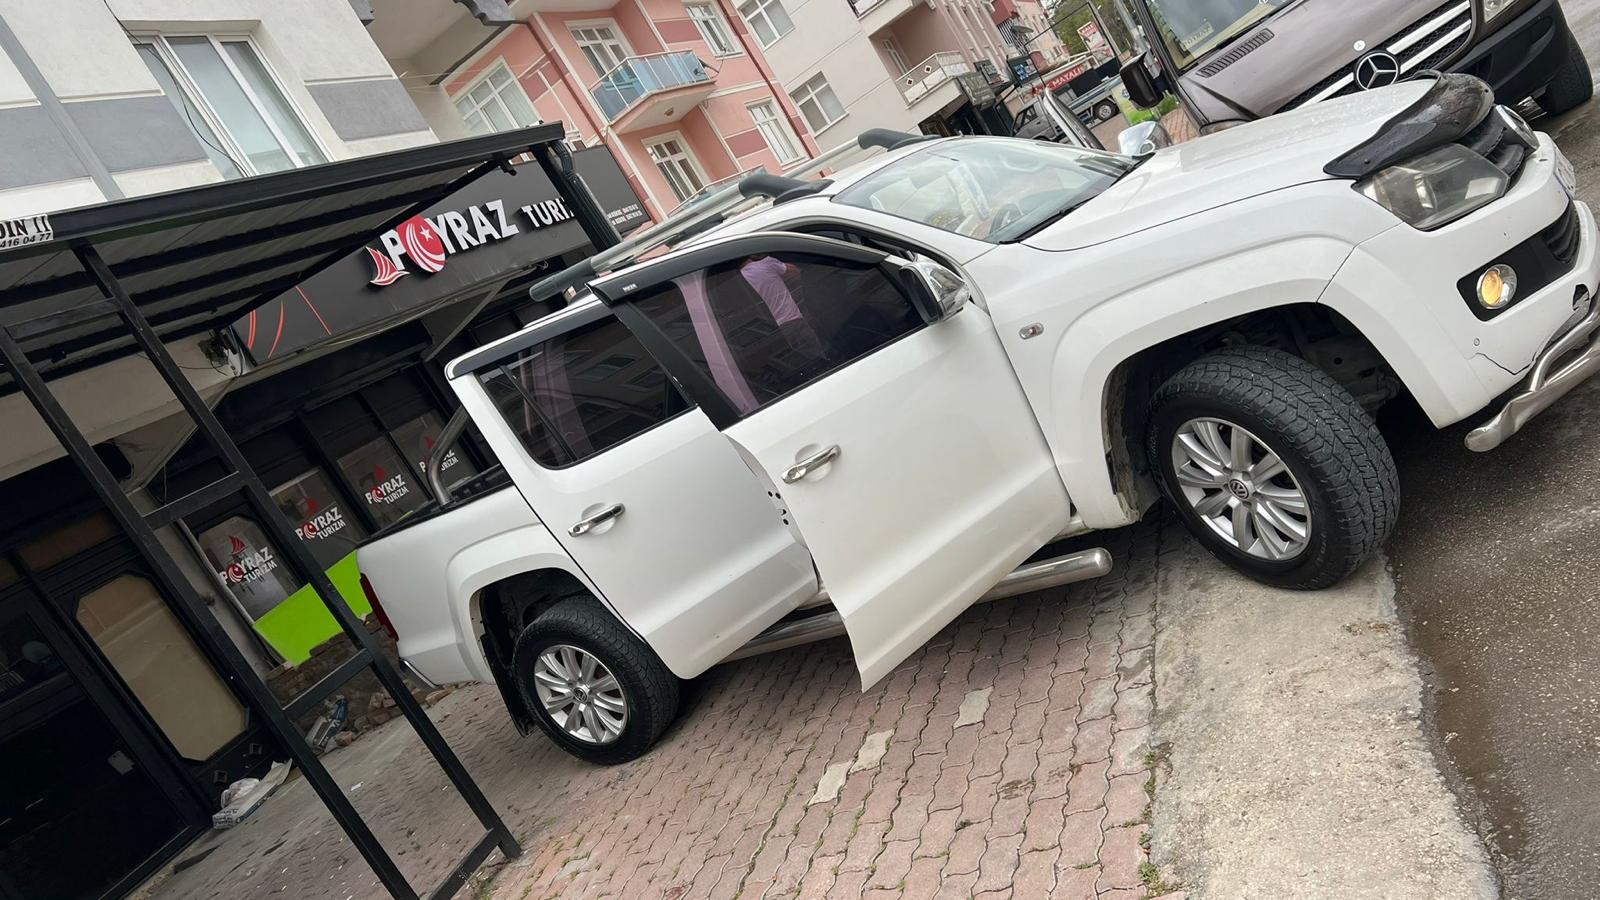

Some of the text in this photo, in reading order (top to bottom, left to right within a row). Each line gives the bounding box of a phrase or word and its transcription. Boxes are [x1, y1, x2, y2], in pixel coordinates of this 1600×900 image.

[39, 232, 51, 241] 77
[379, 197, 574, 273] POYRAZ TURI
[364, 473, 405, 504] POYRAZ
[384, 485, 409, 504] TURIZM
[294, 506, 342, 540] POYRAZ
[316, 519, 346, 540] TURIZM
[219, 546, 273, 585] POYRAZ
[243, 560, 278, 583] TURIZM
